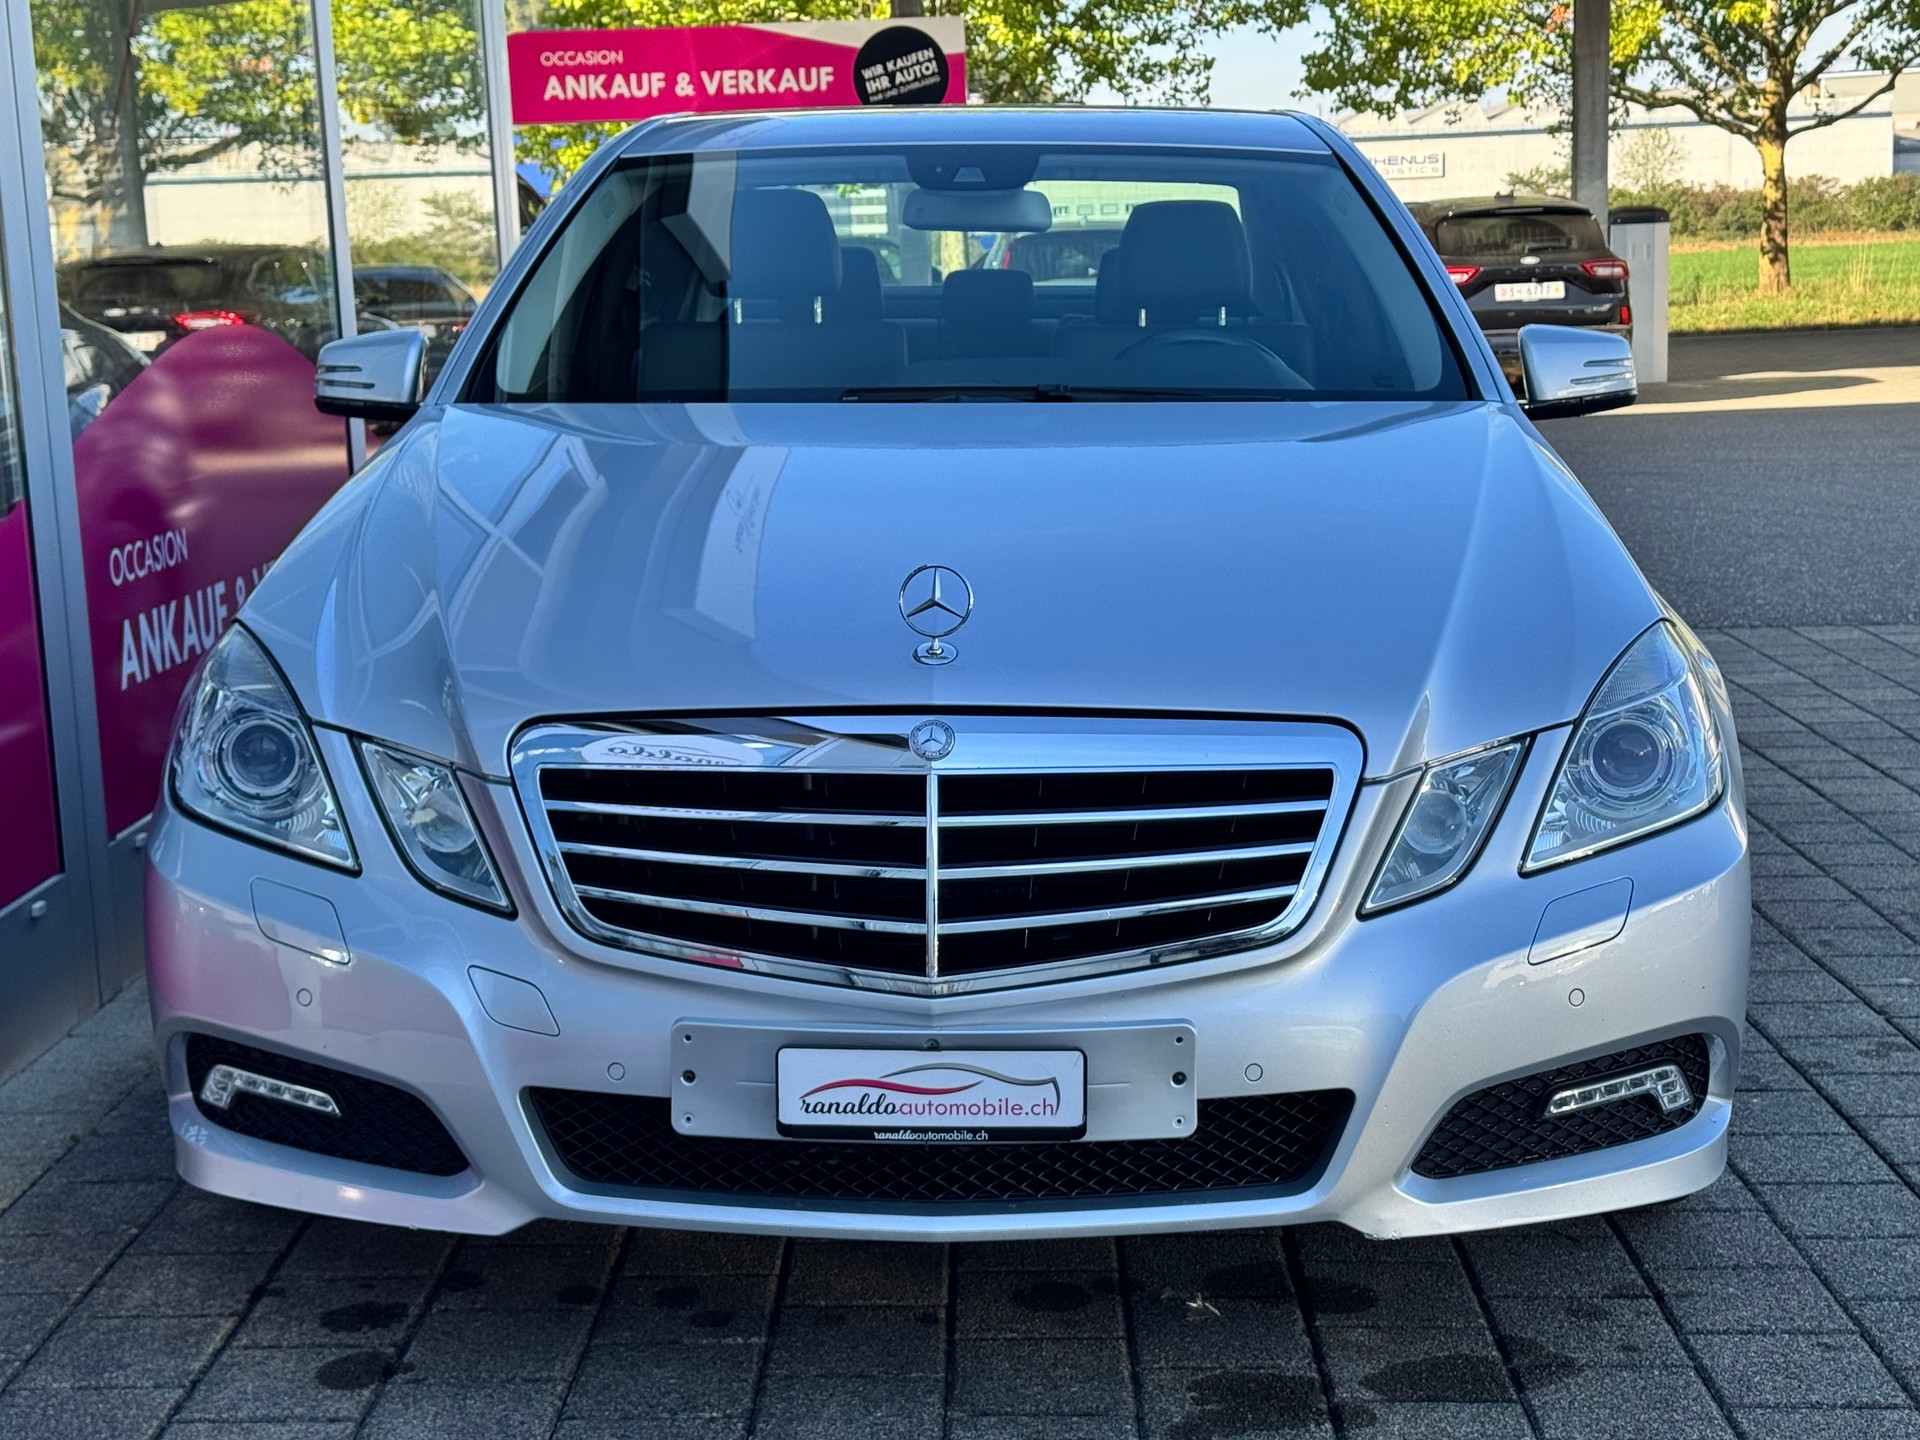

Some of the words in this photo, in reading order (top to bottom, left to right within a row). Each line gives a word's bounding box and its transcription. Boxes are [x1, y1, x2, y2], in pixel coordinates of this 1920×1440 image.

[539, 49, 624, 67] OCCASION
[861, 63, 886, 80] WIR
[886, 46, 935, 73] KAUFEN
[543, 72, 666, 101] ANKAUF
[674, 72, 696, 97] &
[700, 66, 834, 96] VERKAUF
[865, 75, 892, 94] IHR
[895, 59, 939, 86] AUTO!
[109, 528, 189, 587] OCCASION
[121, 580, 228, 692] ANKAUF
